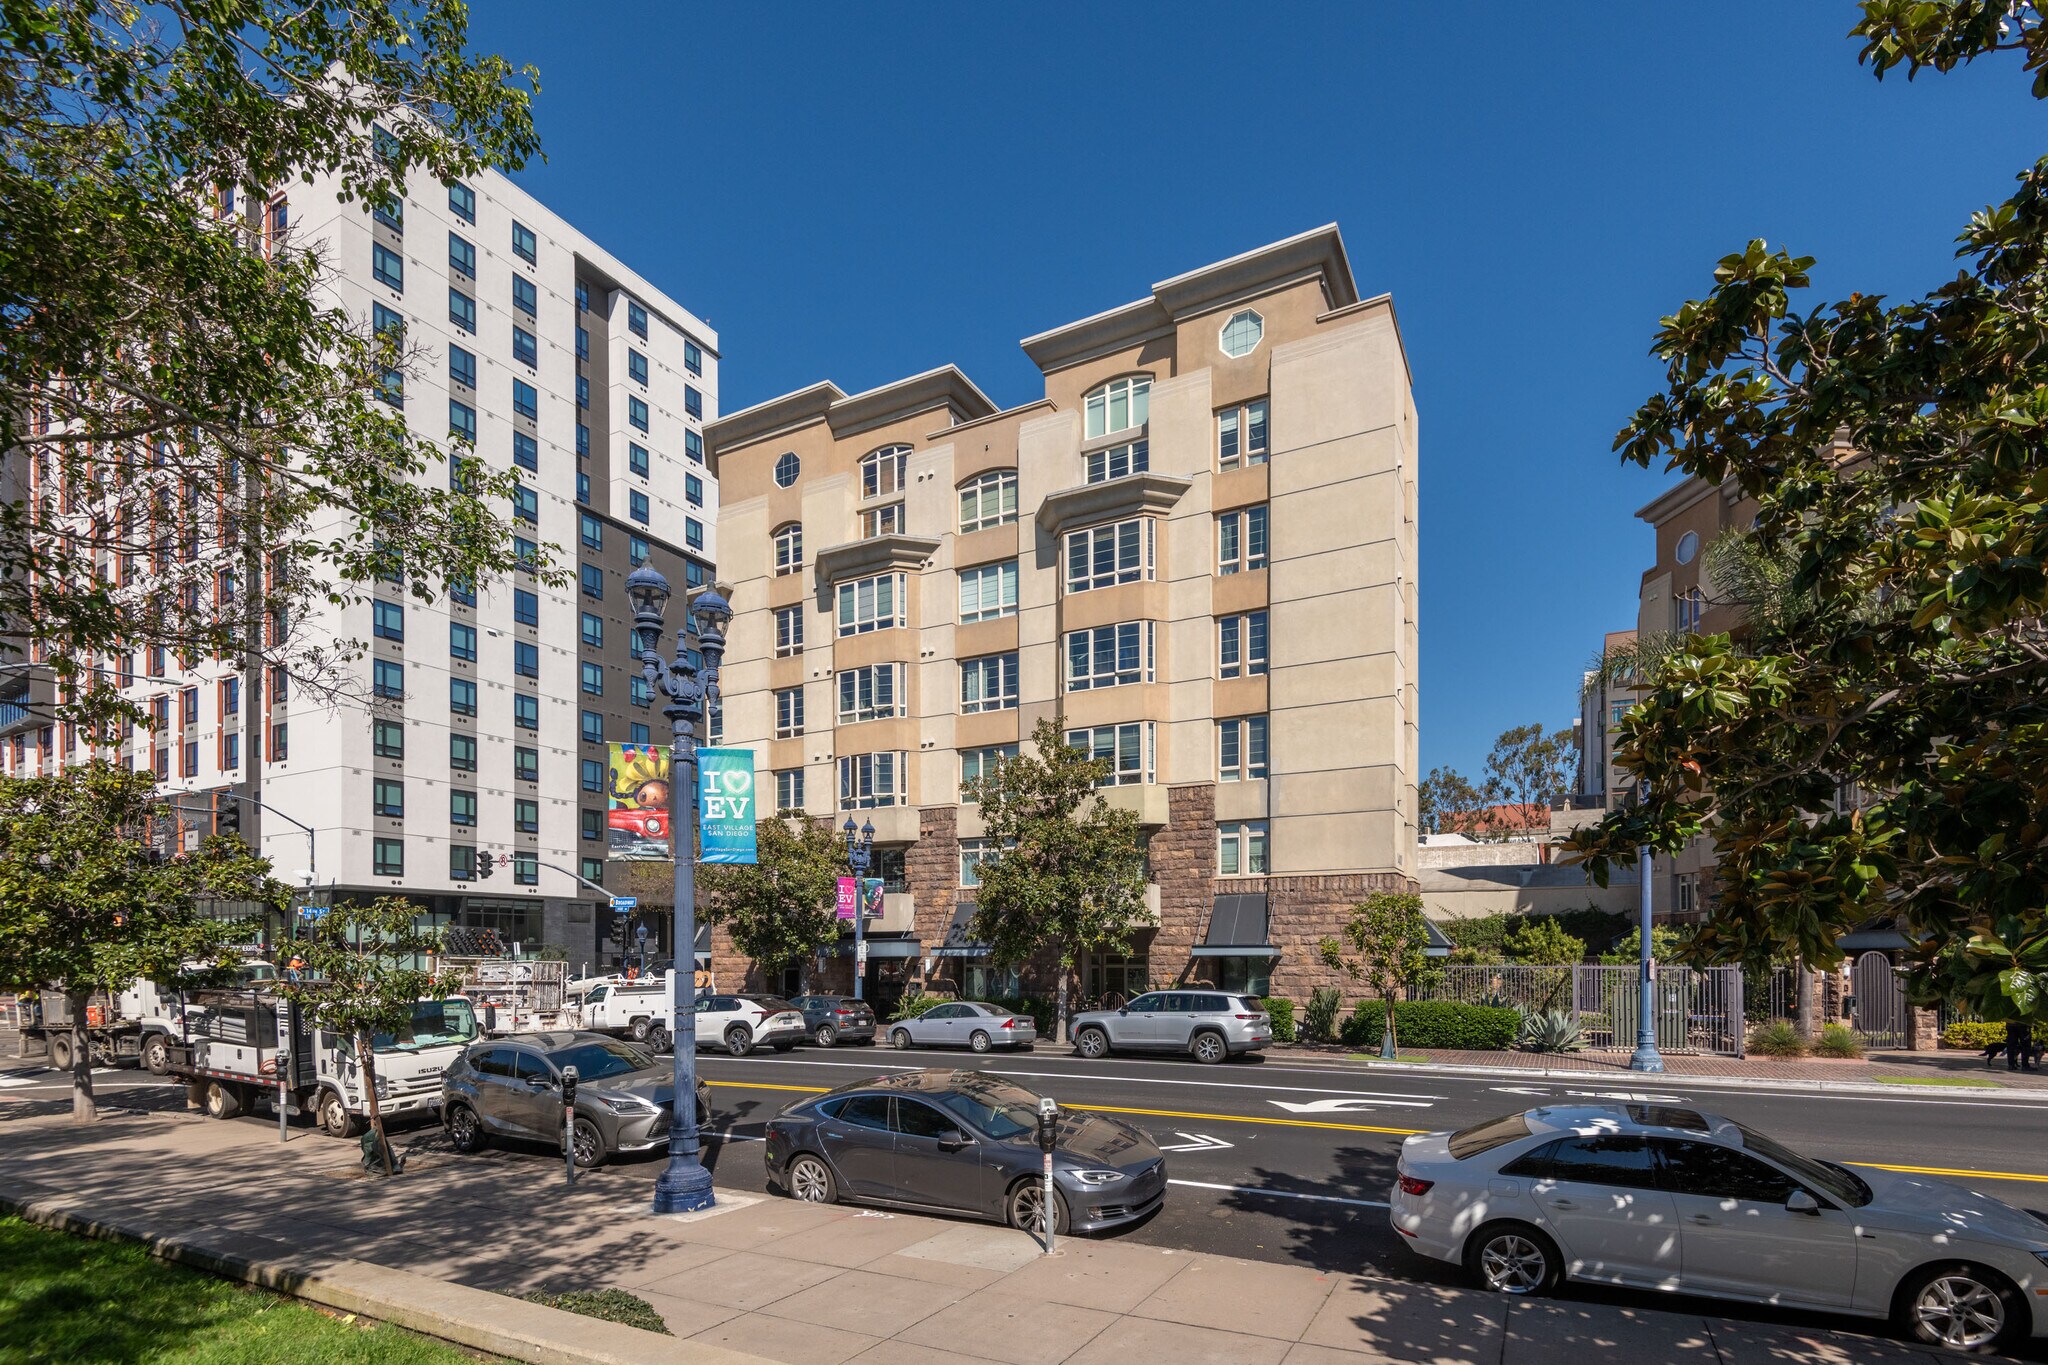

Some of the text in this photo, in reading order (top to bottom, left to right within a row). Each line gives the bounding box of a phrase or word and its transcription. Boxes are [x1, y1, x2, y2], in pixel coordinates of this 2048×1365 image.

[703, 771, 722, 793] I
[704, 796, 751, 819] EV
[839, 885, 845, 893] I
[839, 895, 853, 903] EV
[418, 1066, 444, 1074] ISUZU
